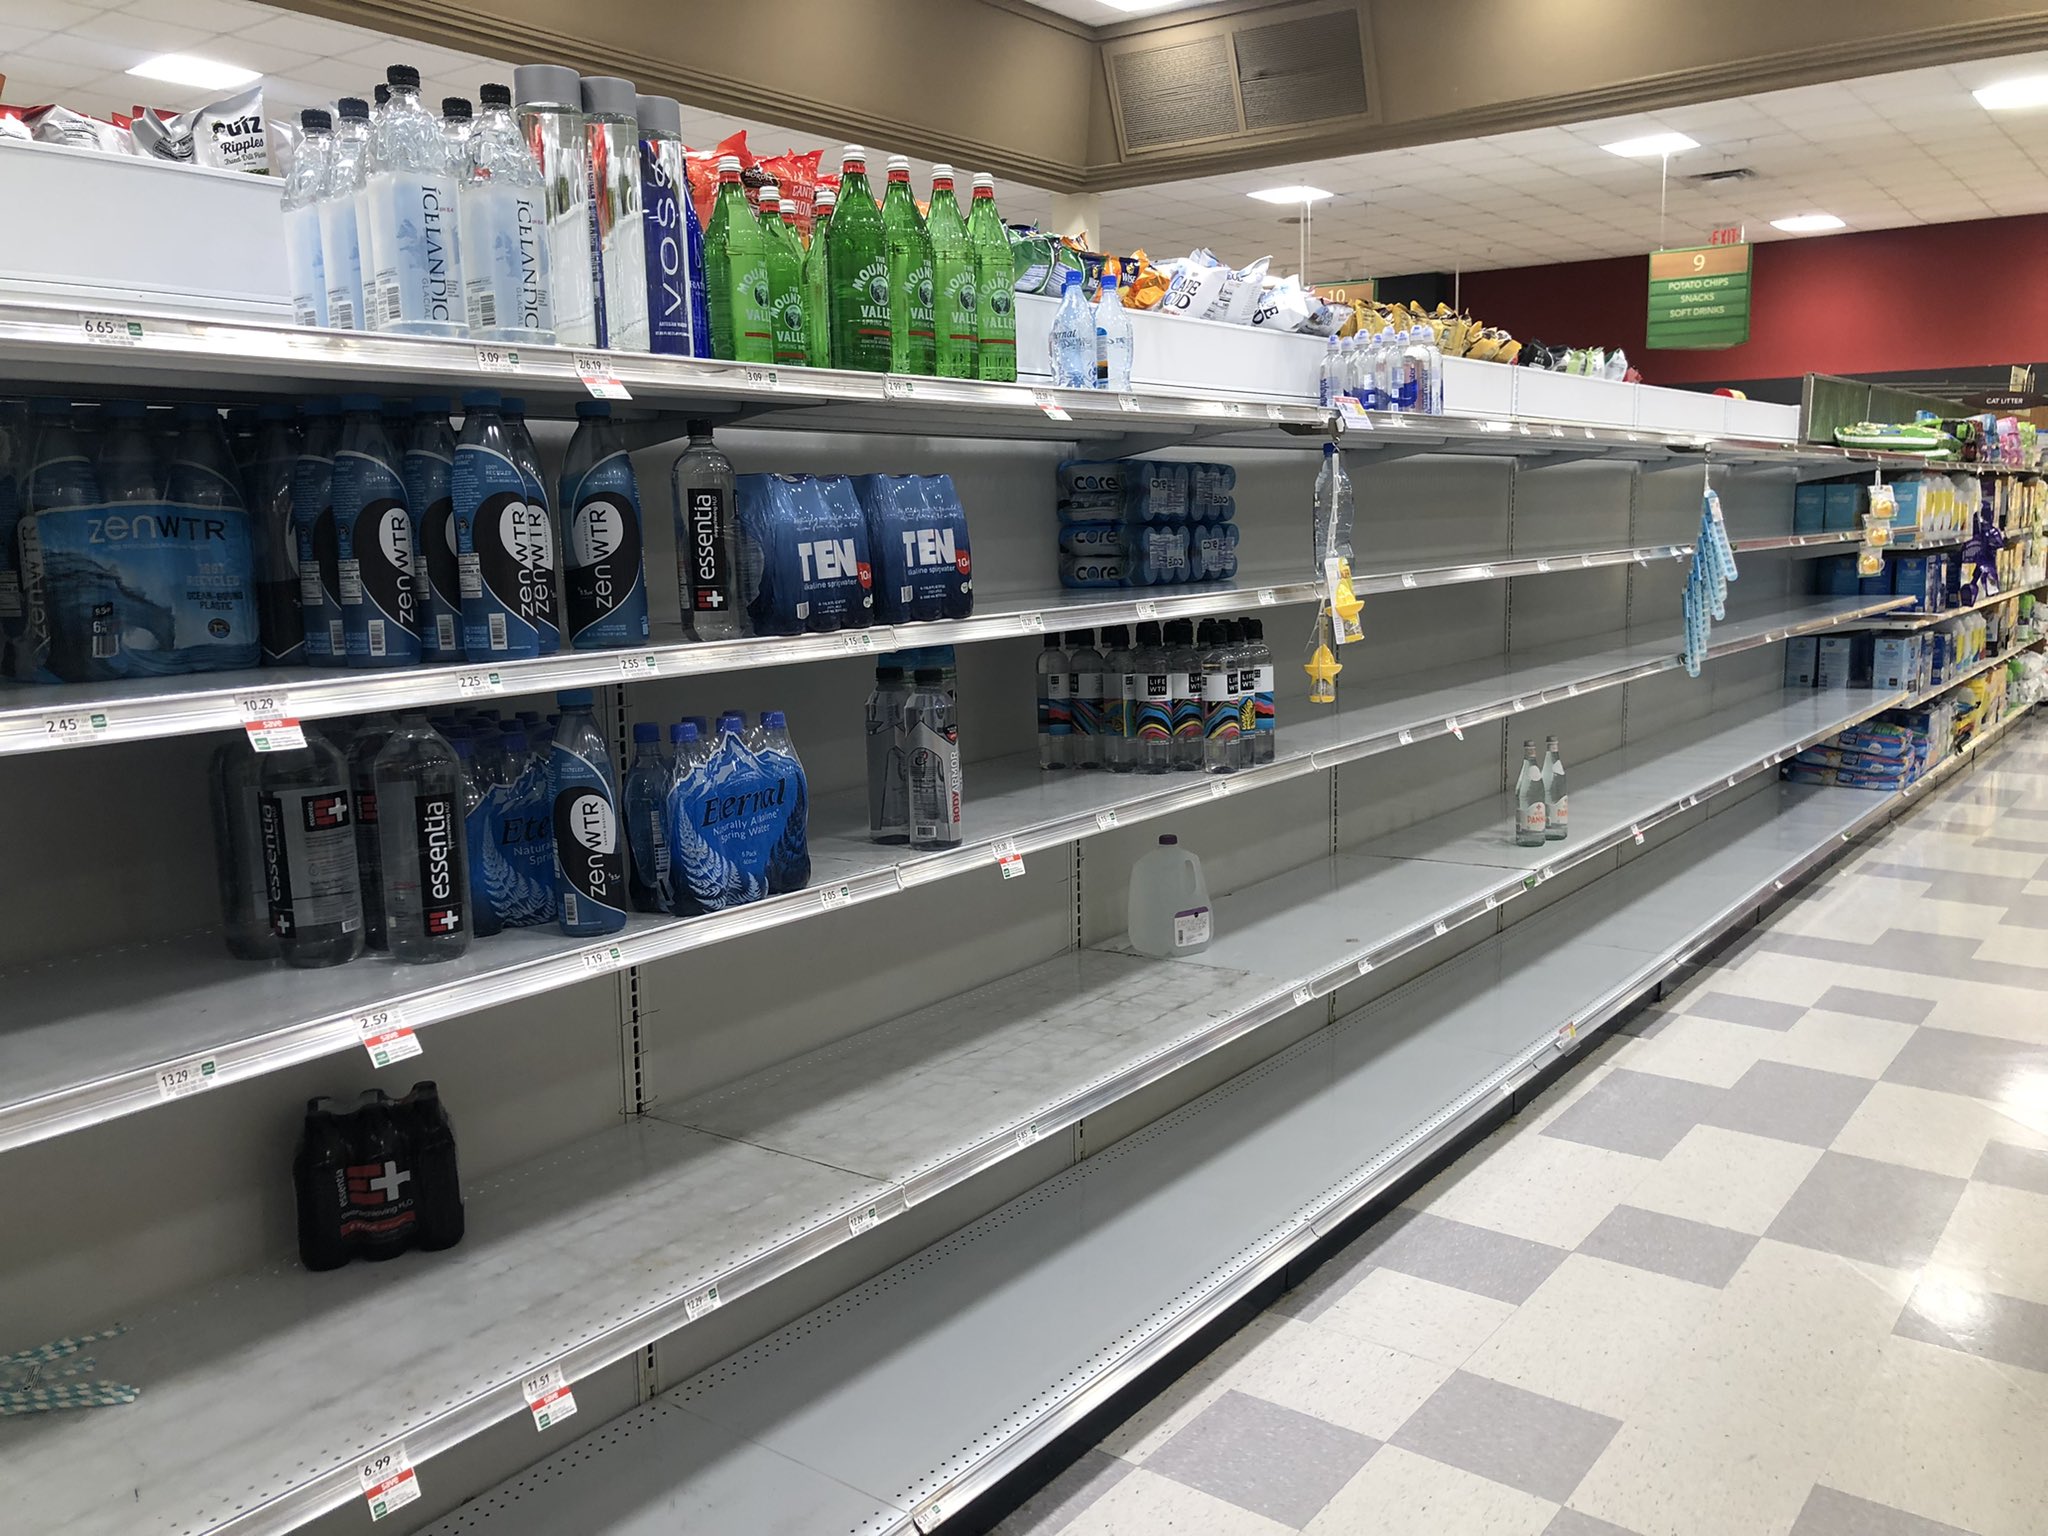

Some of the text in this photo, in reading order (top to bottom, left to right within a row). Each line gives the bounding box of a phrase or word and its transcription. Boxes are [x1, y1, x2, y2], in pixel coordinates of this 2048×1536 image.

[220, 136, 264, 155] Ripples
[655, 157, 682, 316] VOSS
[1712, 227, 1737, 245] EXIT
[875, 255, 885, 264] THE
[1693, 254, 1706, 272] 9
[1122, 272, 1136, 283] WISE
[1668, 278, 1729, 291] POTATO CHIPS
[1171, 275, 1201, 297] CAPE
[1163, 291, 1191, 310] COD
[1327, 288, 1346, 301] 10
[1680, 292, 1715, 304] SNACKS
[1669, 306, 1725, 318] SOFT DRINKS
[85, 320, 114, 334] 6.65
[480, 352, 499, 363] 3.09
[578, 359, 601, 370] 2/6.19
[747, 372, 762, 382] 3.09
[1074, 476, 1120, 490] core
[693, 494, 715, 580] essentia
[1075, 530, 1118, 544] core
[902, 528, 957, 568] TEN
[797, 538, 859, 582] TEN
[1076, 566, 1120, 580] core
[622, 658, 639, 669] 2.55
[459, 676, 481, 688] 2.25
[1149, 677, 1166, 686] LIFE
[1149, 685, 1166, 693] WTR
[243, 698, 274, 711] 10.29
[47, 718, 78, 733] 2.45
[701, 778, 787, 828] Eernal
[713, 820, 748, 836] Naurally
[721, 824, 770, 844] Spring Water
[262, 804, 281, 902] essentia
[424, 801, 450, 899] essentia
[822, 890, 837, 902] 2.05
[584, 953, 603, 966] 7.19
[360, 1012, 388, 1029] 2.59
[161, 1070, 189, 1086] 13.29
[527, 1374, 550, 1392] 11.51
[364, 1455, 391, 1477] 6.99
